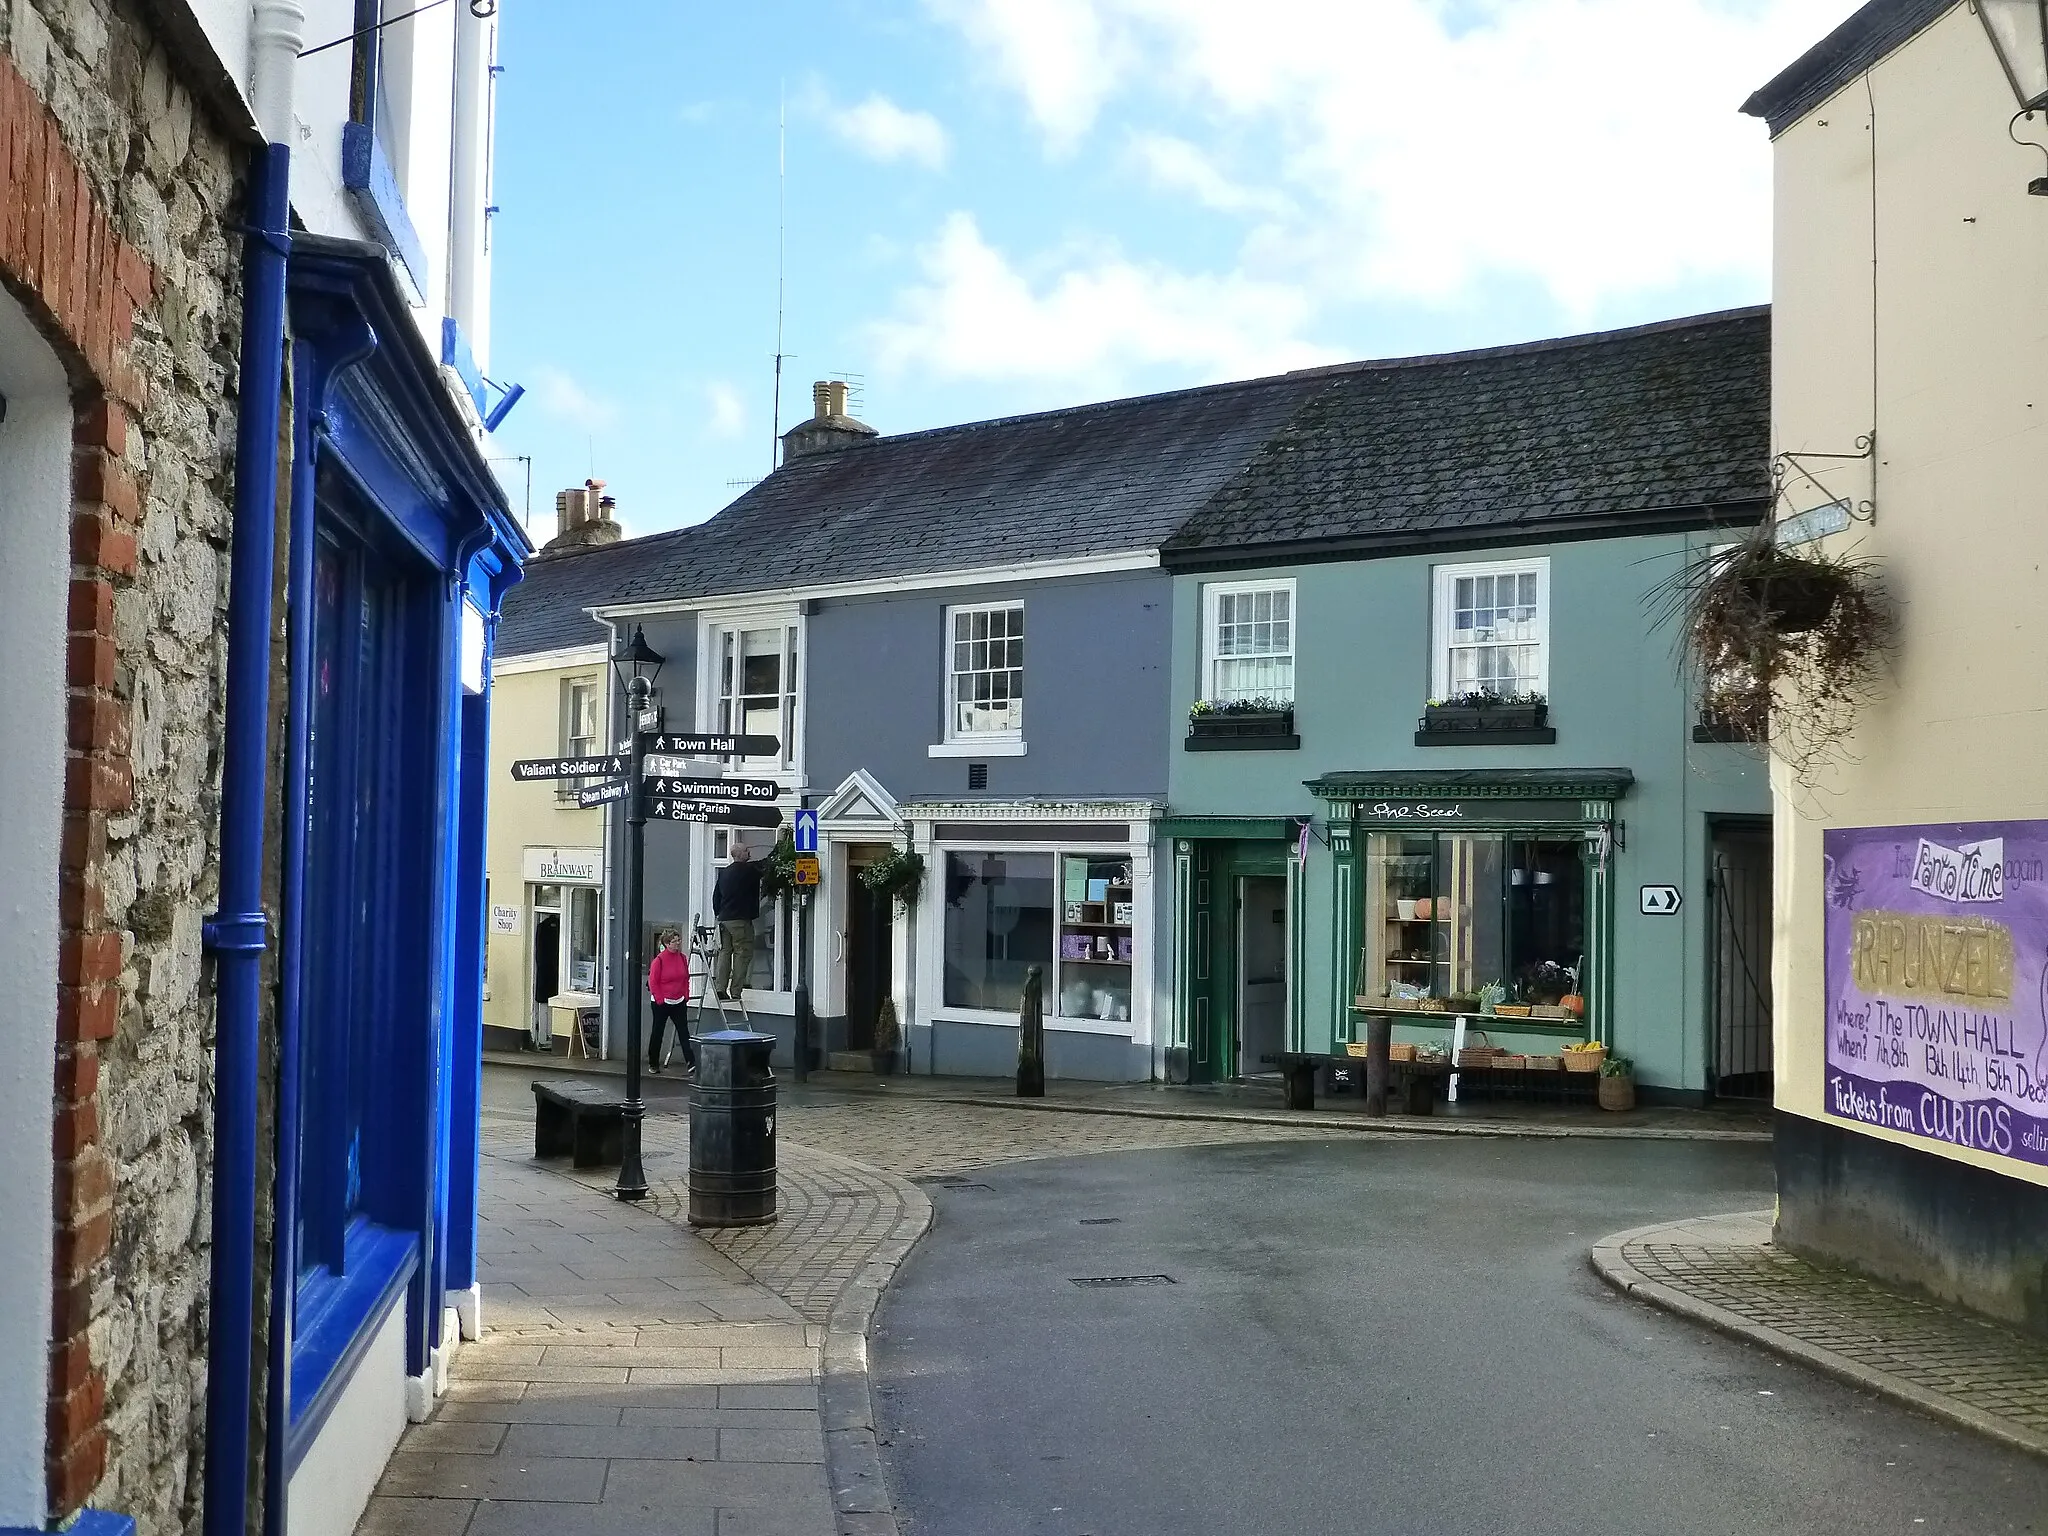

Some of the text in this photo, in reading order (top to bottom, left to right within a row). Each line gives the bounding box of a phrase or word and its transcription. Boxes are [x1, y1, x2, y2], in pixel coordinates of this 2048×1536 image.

[672, 737, 735, 751] Town Hall
[520, 763, 557, 777] Valiant
[560, 761, 600, 775] Soldier
[581, 785, 623, 804] Steam Railway
[672, 780, 773, 797] Swimming Pool
[672, 800, 731, 814] New Parish
[1413, 804, 1463, 818] Seed
[672, 810, 709, 822] Church
[540, 862, 594, 880] BRAINWAVE
[1960, 846, 2002, 899] Time
[2004, 854, 2044, 891] again
[493, 905, 518, 920] Charity
[498, 918, 513, 932] Shop
[1858, 919, 2009, 999] RAPUNZEL
[1836, 999, 2025, 1058] Where? The TOWN HALL
[1836, 1029, 1867, 1061] When?
[1985, 1056, 2012, 1095] 15th
[1831, 1075, 1878, 1122] Tickets
[1879, 1086, 1916, 1132] from
[1919, 1092, 2014, 1156] CURIOS
